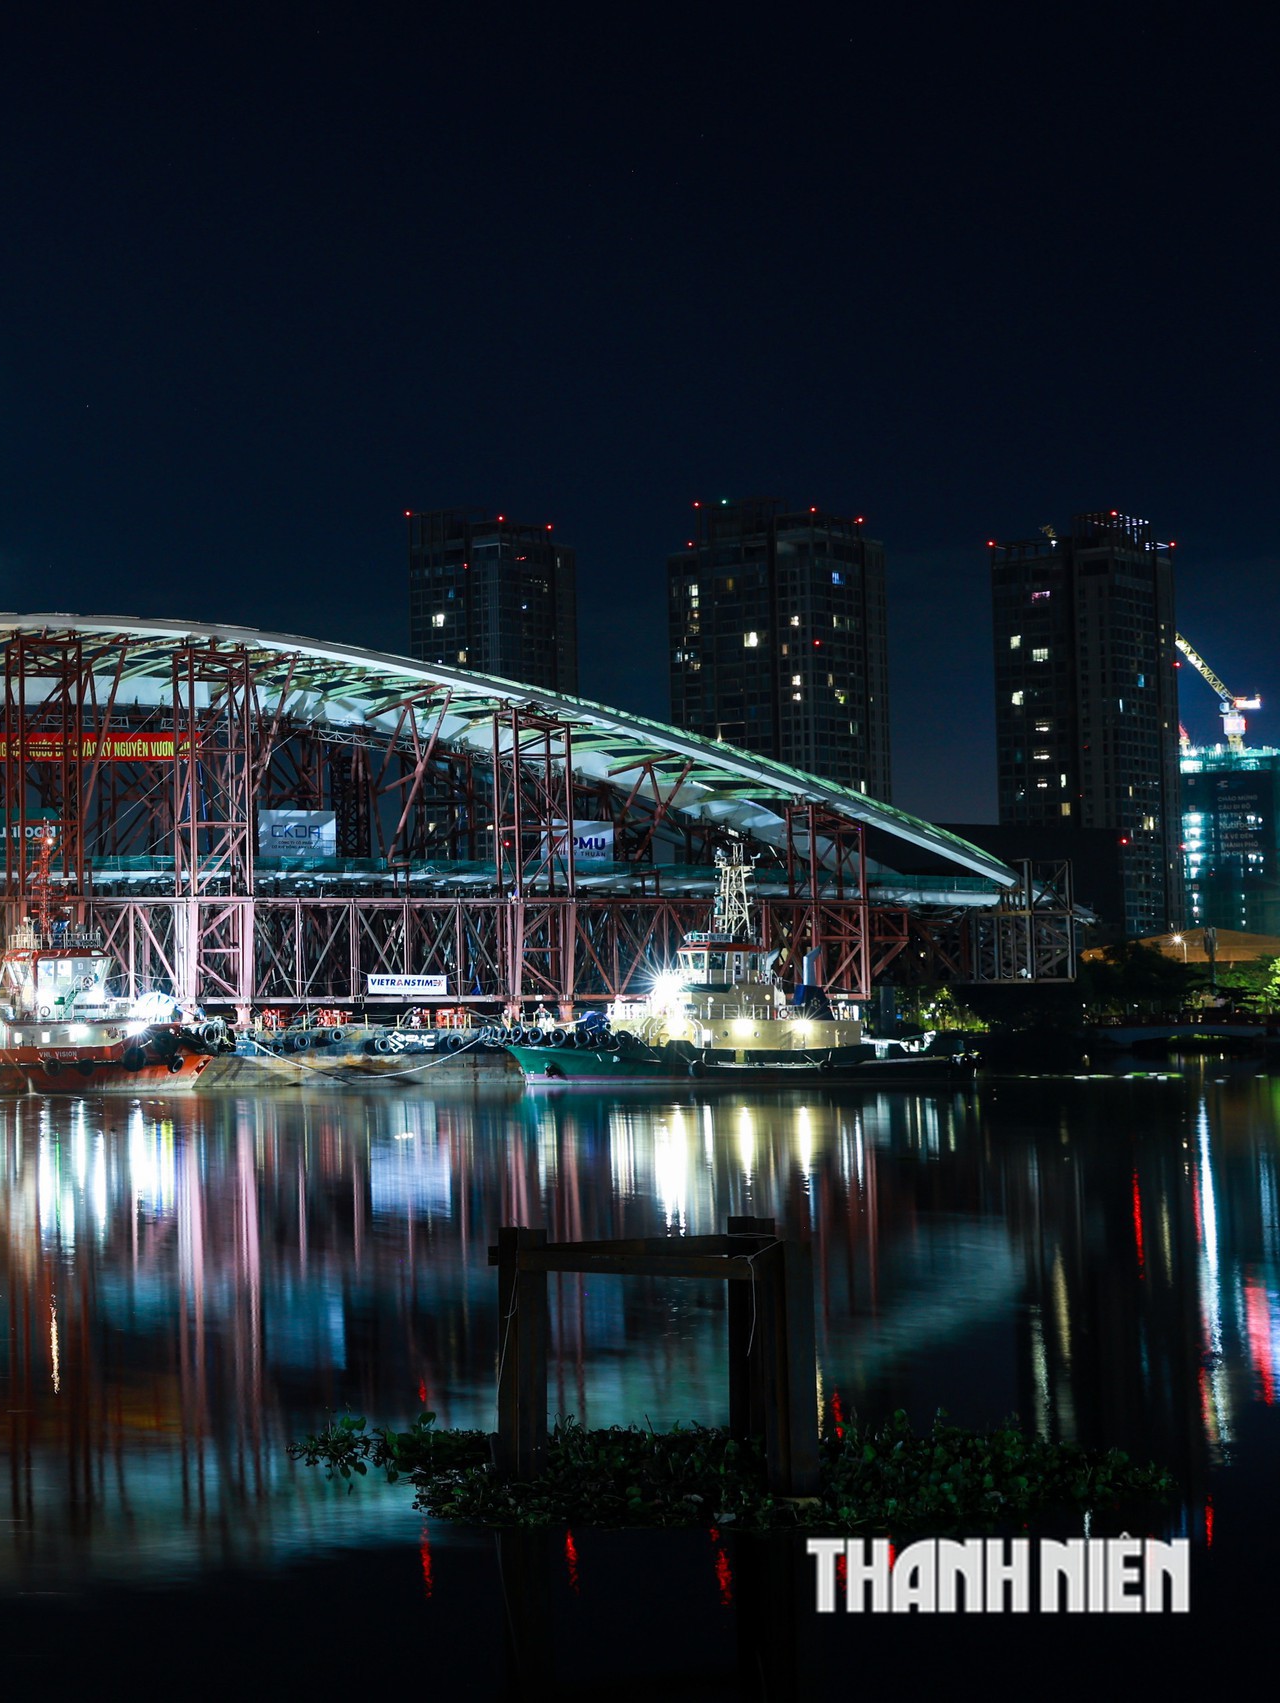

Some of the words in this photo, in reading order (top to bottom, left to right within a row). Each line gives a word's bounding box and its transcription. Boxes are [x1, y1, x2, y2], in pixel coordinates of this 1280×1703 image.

[114, 739, 148, 757] NGUYÊN
[150, 741, 174, 757] VƯƠN
[370, 978, 444, 987] VIETRANSTIMEX
